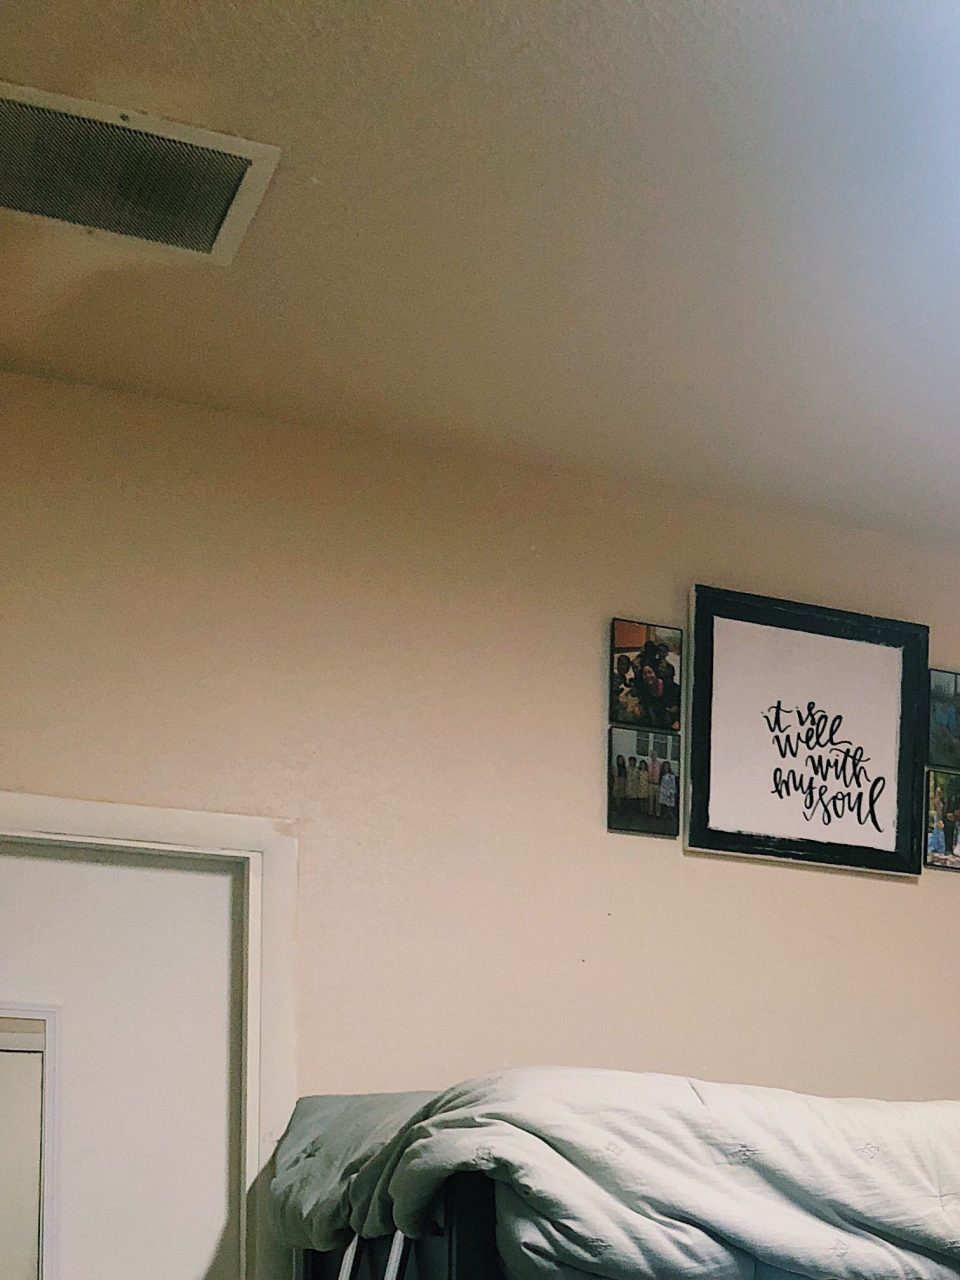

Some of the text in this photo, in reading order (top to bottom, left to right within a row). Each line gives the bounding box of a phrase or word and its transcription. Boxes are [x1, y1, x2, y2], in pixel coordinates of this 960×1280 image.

[761, 700, 826, 733] it is
[772, 714, 852, 759] well
[806, 746, 871, 788] with
[771, 767, 886, 833] my soul
